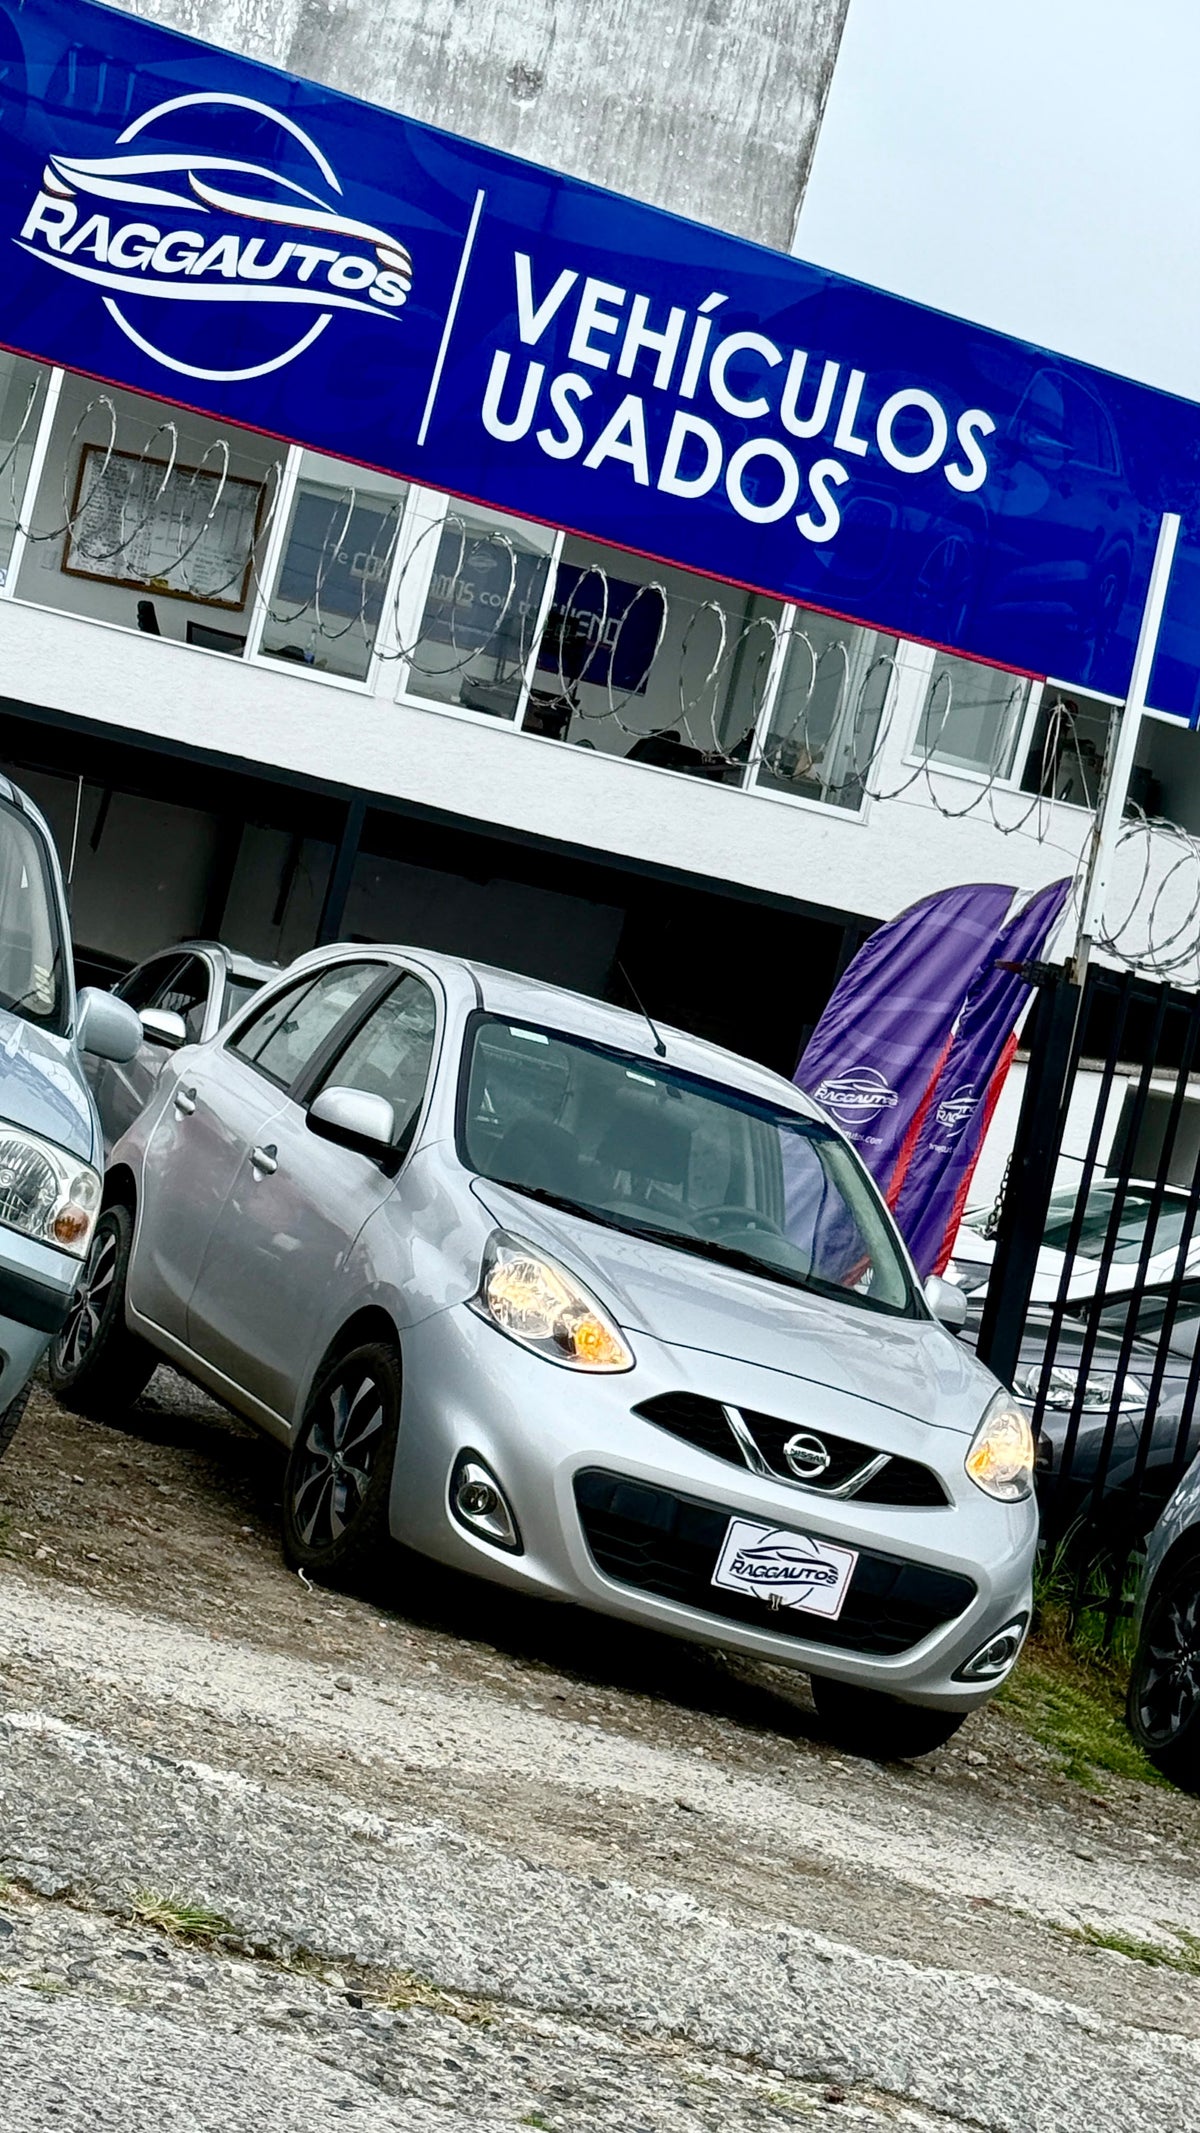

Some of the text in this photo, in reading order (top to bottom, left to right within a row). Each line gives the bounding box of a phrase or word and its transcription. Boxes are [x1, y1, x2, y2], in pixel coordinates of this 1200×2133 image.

[20, 191, 413, 307] RAGGAUTOS
[513, 252, 996, 493] VEHÍCULOS
[481, 350, 851, 544] USADOS
[814, 1087, 899, 1106] RAGGAUTOS
[790, 1447, 826, 1464] NISSAN
[729, 1558, 839, 1585] RAGGAUTOS
